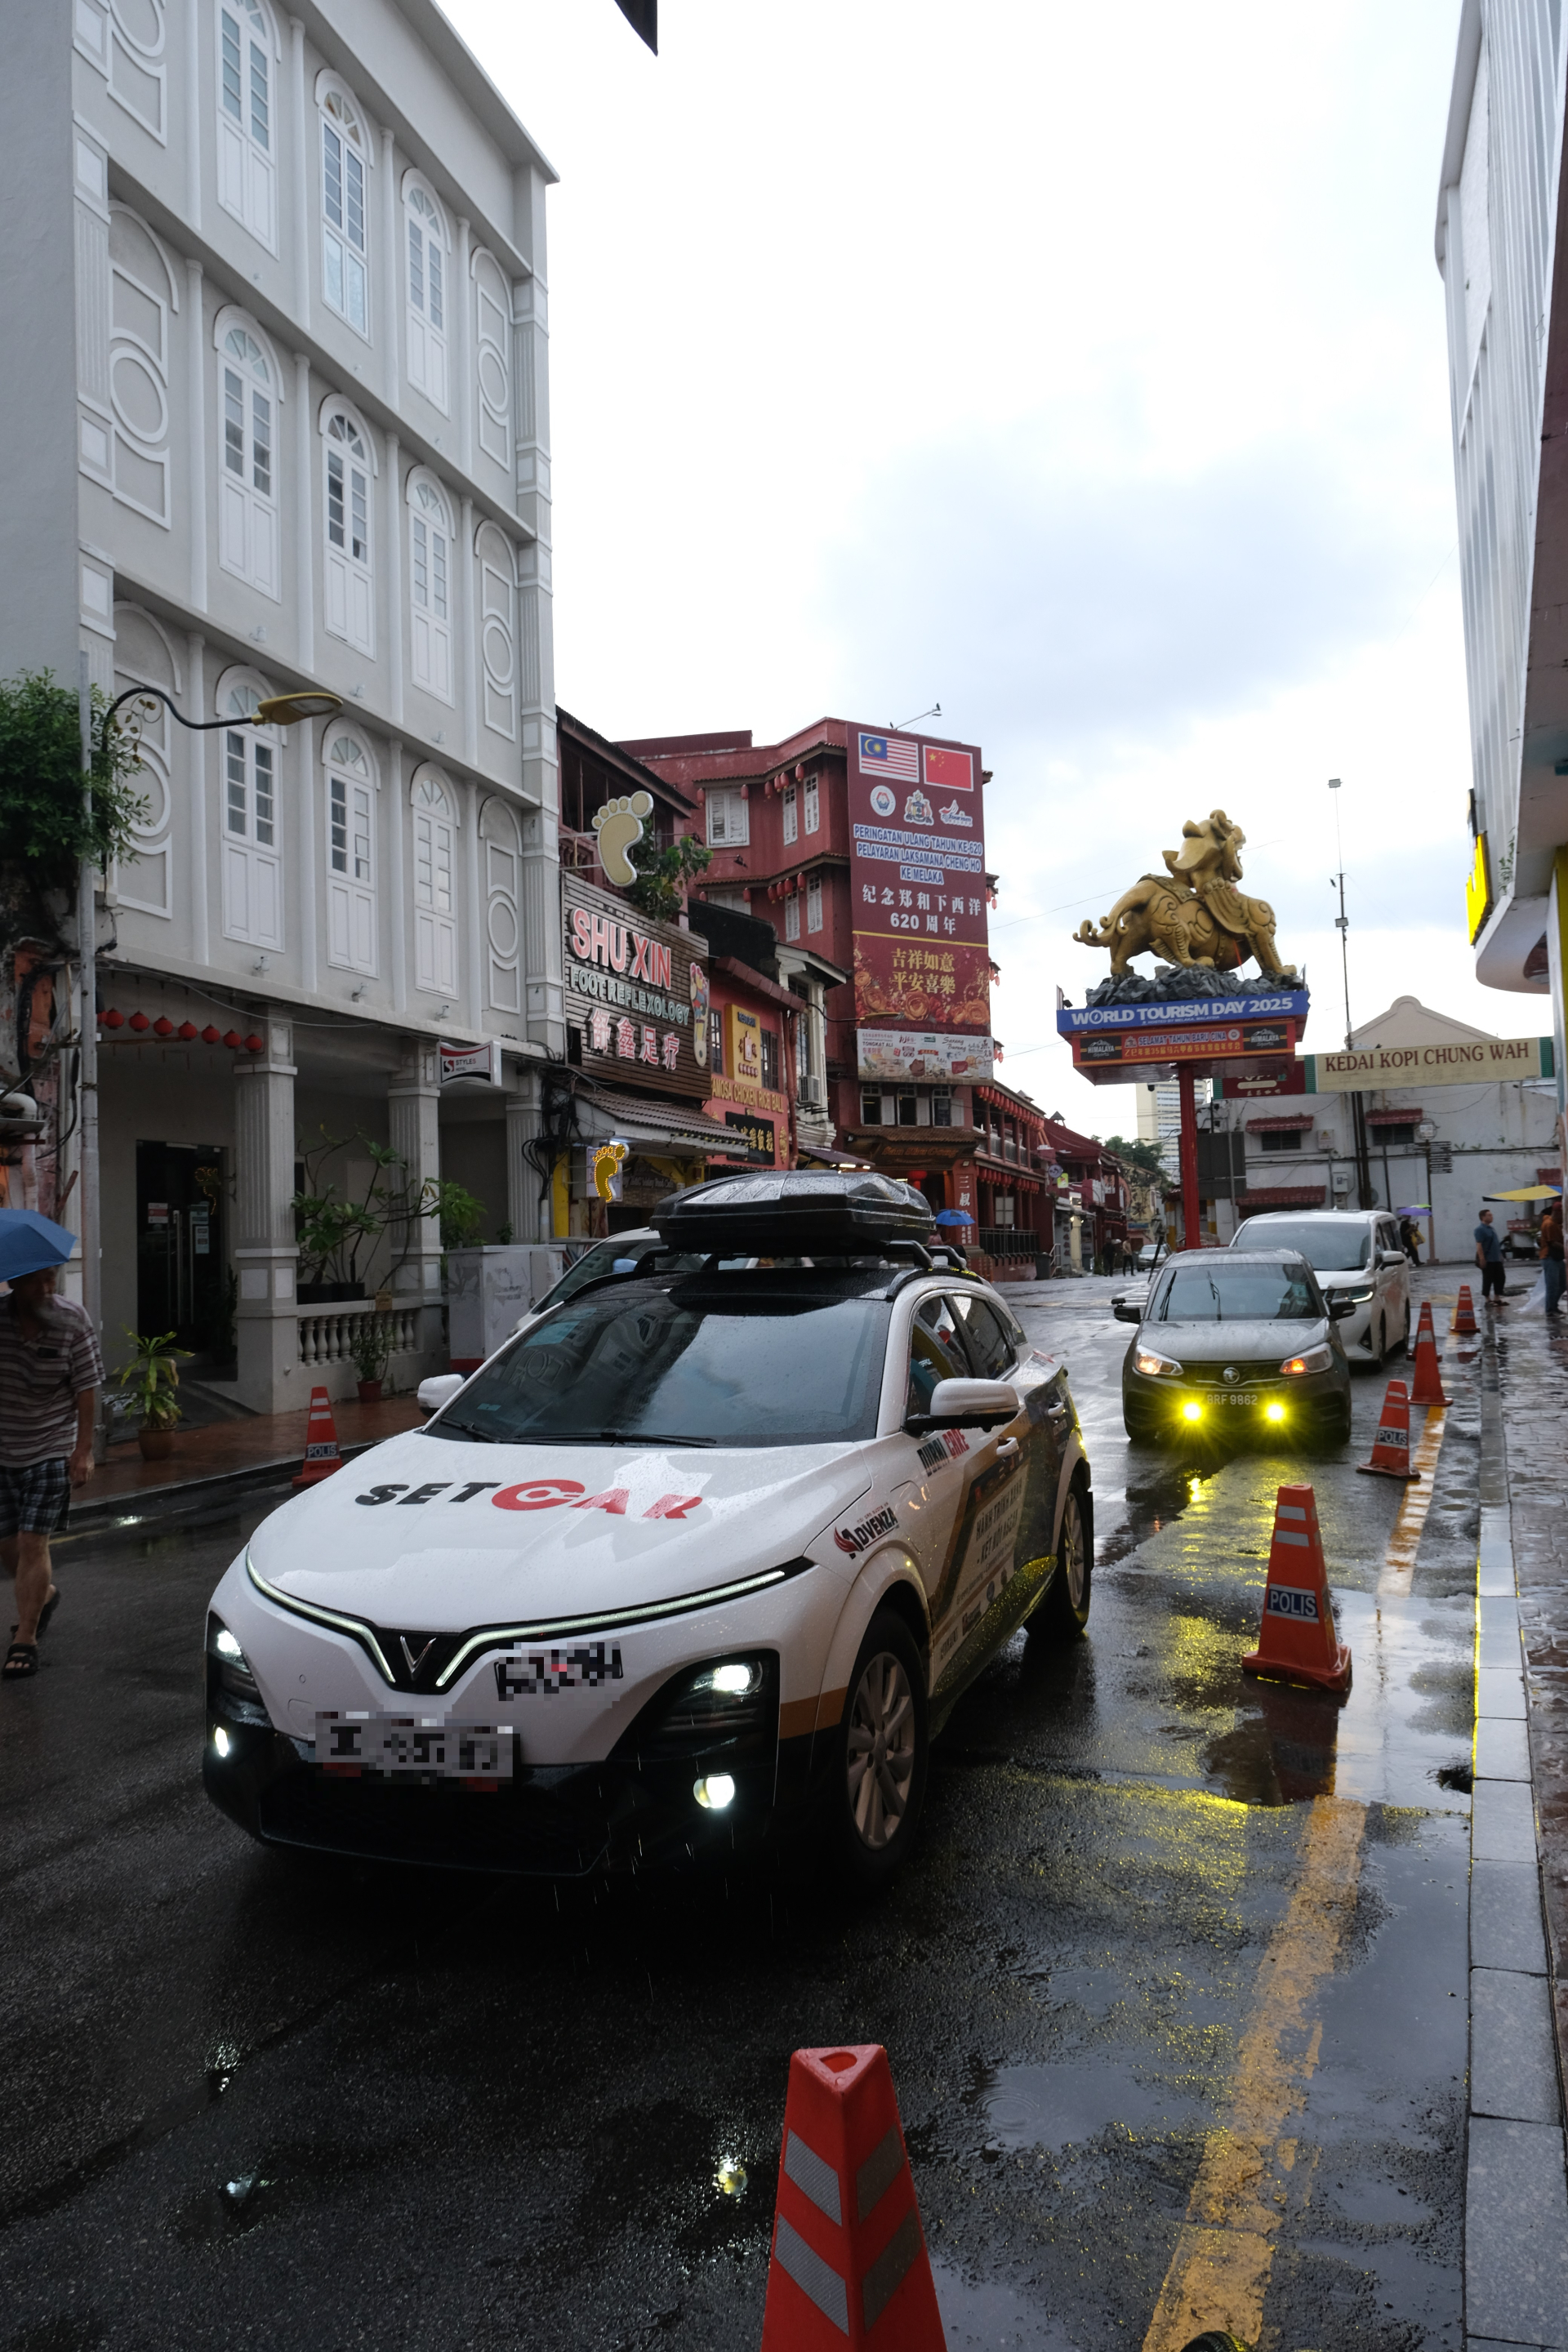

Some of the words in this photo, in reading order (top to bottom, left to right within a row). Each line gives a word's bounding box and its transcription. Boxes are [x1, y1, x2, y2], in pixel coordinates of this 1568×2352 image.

[854, 824, 902, 844] PERINGATAN
[904, 831, 930, 848] ULANG
[932, 835, 956, 852] TAHUN
[957, 840, 982, 856] KE-620
[857, 842, 900, 860] PELAYARAN
[902, 849, 944, 867] LAKSAMANA
[946, 855, 969, 871] CHENG
[970, 860, 982, 873] HO
[900, 866, 912, 880] KE
[913, 867, 944, 884] MELAKA
[862, 884, 982, 915] 纪念郑和下西洋
[572, 907, 627, 973] SHU
[630, 931, 671, 991] XIN
[891, 947, 956, 973] 吉祥如意
[571, 966, 606, 996] FOOT
[608, 981, 690, 1025] REFLEXOLOGY
[891, 971, 956, 995] 平安喜樂
[1071, 1008, 1133, 1025] WORLD
[1137, 1003, 1208, 1021] TOURISM
[1212, 1000, 1246, 1017] DAY
[1249, 996, 1293, 1013] 2025
[591, 1008, 679, 1071] 舒鑫足疗
[1088, 1045, 1115, 1054] HIMALAYA
[1138, 1035, 1168, 1046] SELAMAT
[1169, 1033, 1191, 1045] TAHUN
[1192, 1032, 1209, 1043] BARU
[1210, 1031, 1227, 1042] CINA
[1250, 1034, 1280, 1043] HIMALAYA
[1325, 1053, 1374, 1072] KEDAI
[1379, 1050, 1419, 1068] KOPI
[1424, 1045, 1484, 1065] CHUNG
[1489, 1042, 1530, 1061] WAH
[711, 1077, 732, 1101] AMOSA
[733, 1084, 757, 1108] CHICKEN
[758, 1090, 771, 1110] RICE
[772, 1094, 785, 1113] BALL
[1207, 1394, 1227, 1405] BRF
[1230, 1394, 1258, 1405] 9862
[1378, 1430, 1407, 1445] POLIS
[308, 1446, 336, 1458] POLIS
[1270, 1590, 1316, 1616] POLIS
